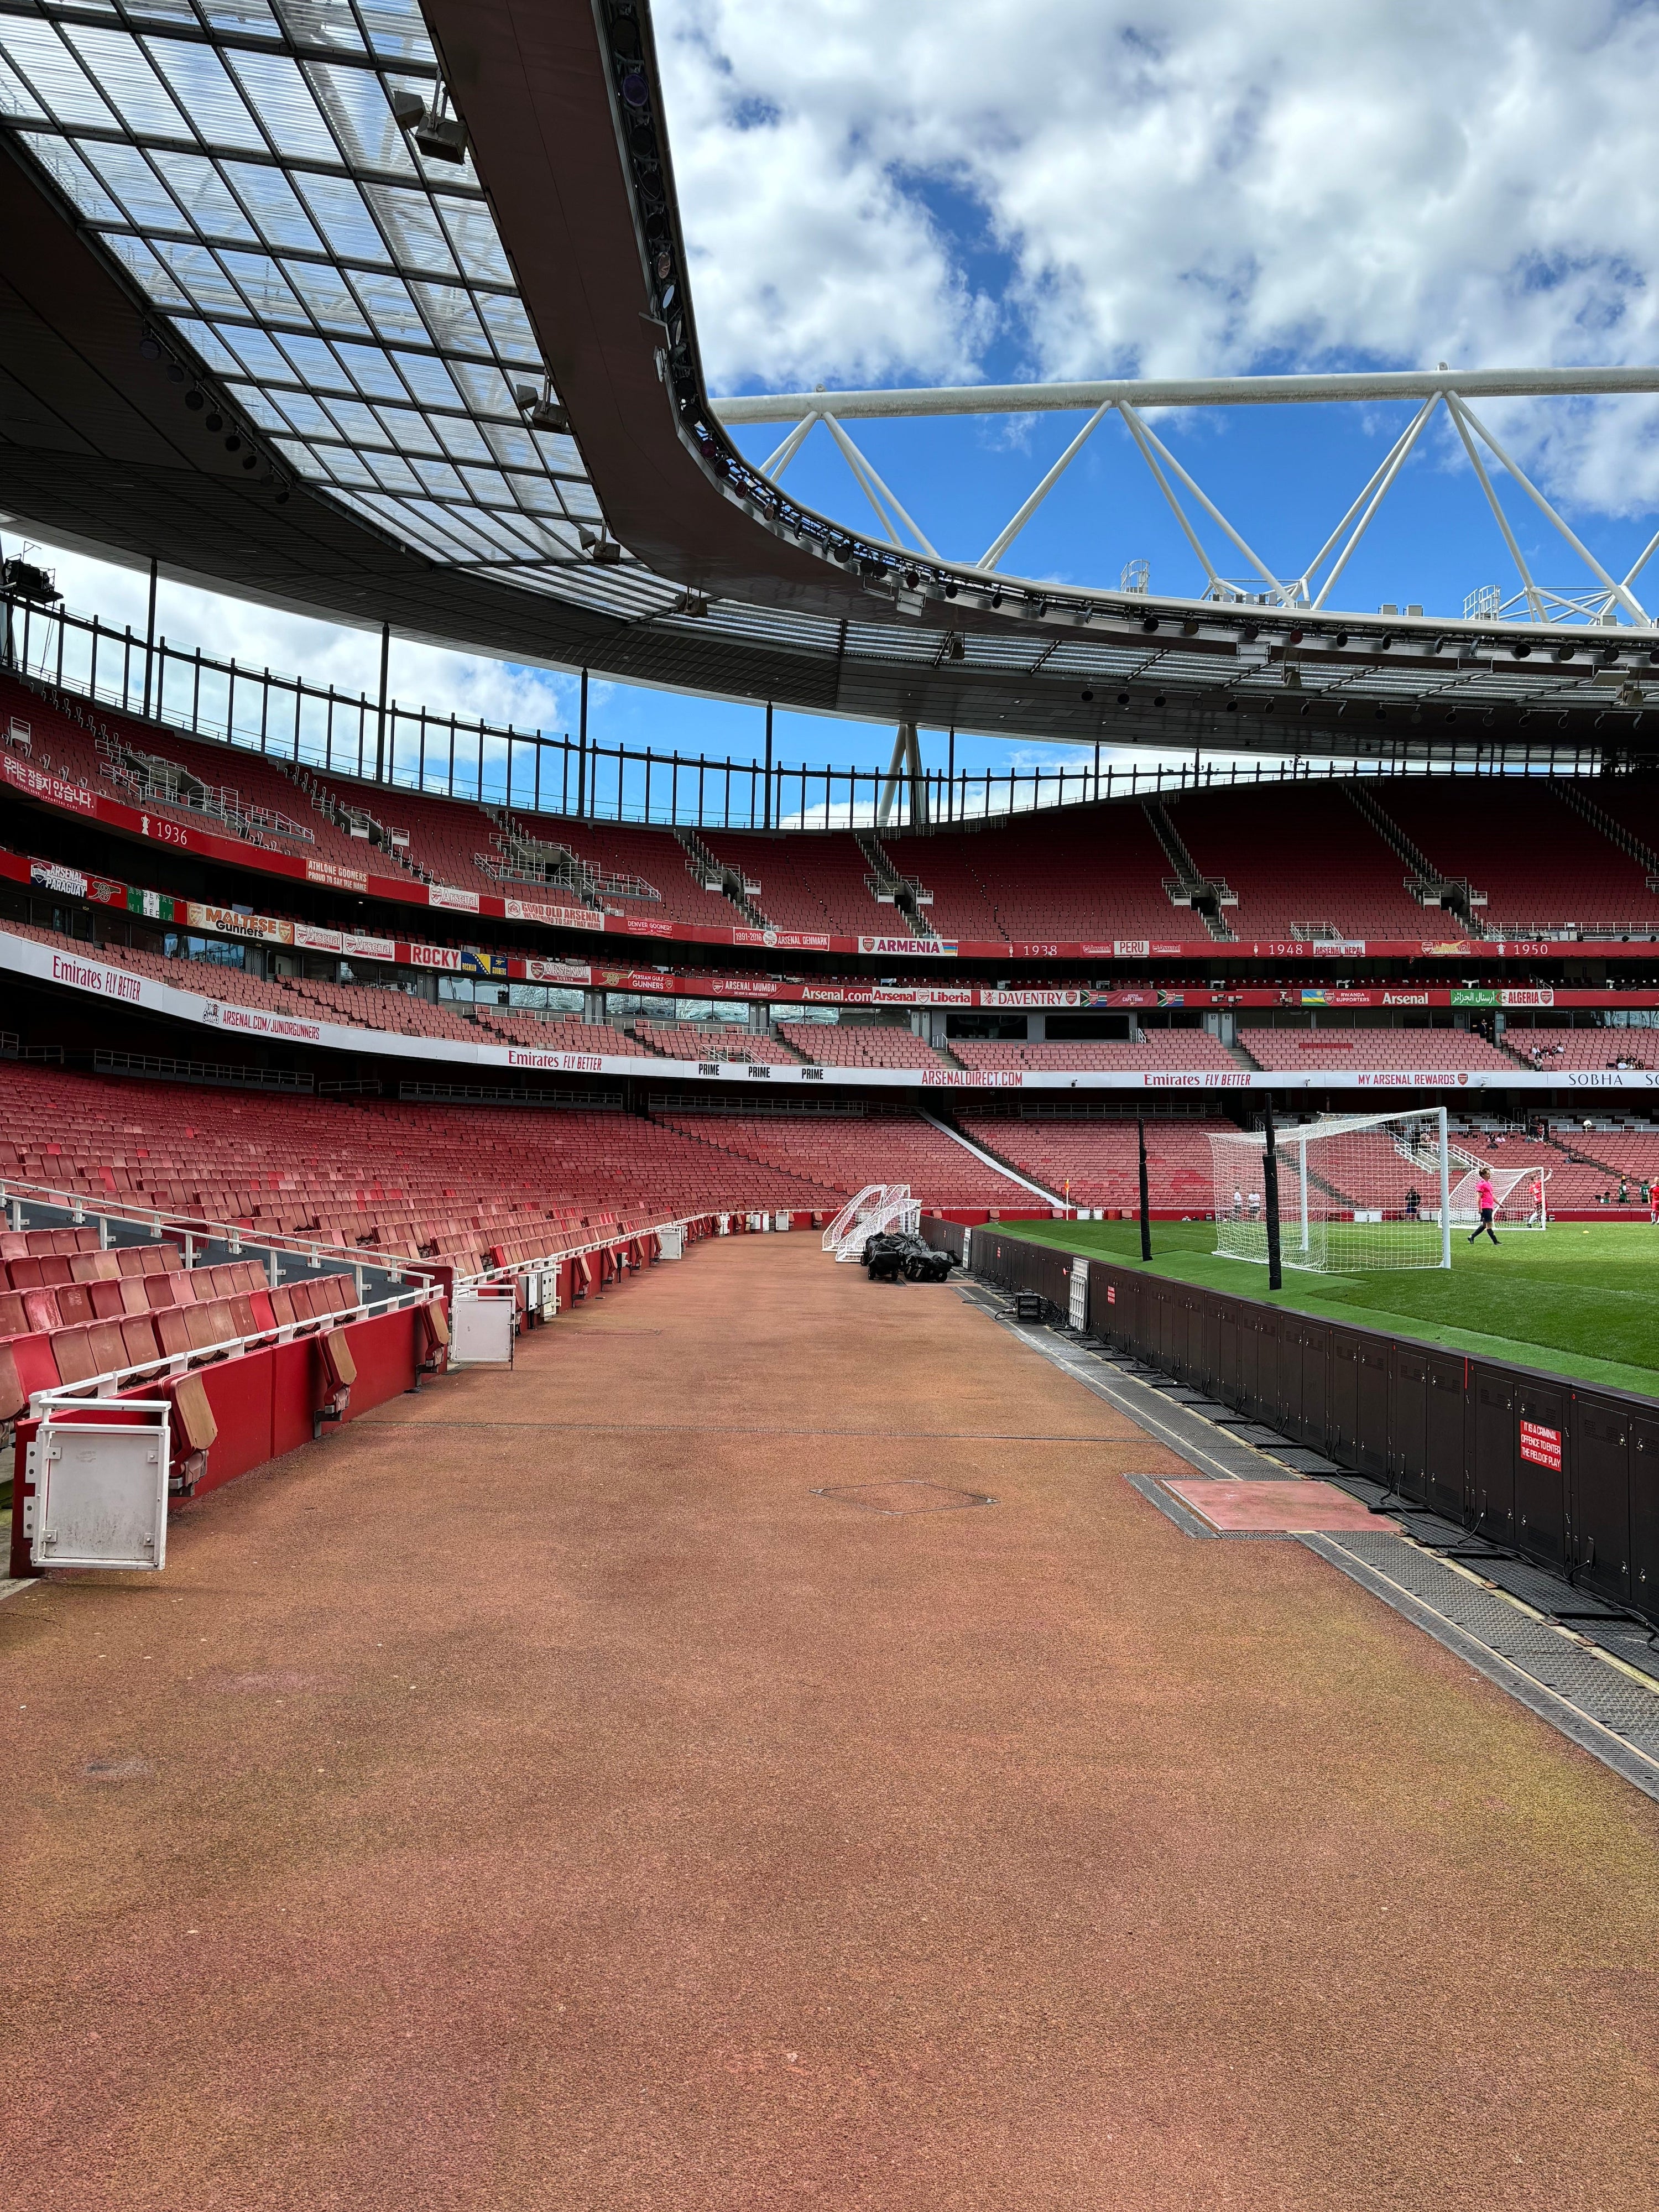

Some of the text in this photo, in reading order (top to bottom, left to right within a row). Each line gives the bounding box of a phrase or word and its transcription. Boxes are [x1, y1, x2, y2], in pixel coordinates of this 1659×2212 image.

[3, 756, 94, 808] 우리는 잠들지 않습니다.
[157, 822, 187, 846] 1936
[50, 864, 84, 884] ARSENAL
[308, 860, 367, 883] ATHLONE GOONERS
[45, 877, 86, 898] PARAGUAY
[308, 871, 325, 883] PROUD
[326, 875, 333, 884] TO
[333, 877, 343, 886] SAY
[353, 882, 367, 892] NAME
[444, 888, 478, 907] Arsenal
[521, 902, 601, 922] GOOD OLD ARSENAL
[206, 907, 277, 934] MALTESE
[649, 923, 672, 932] GOONERS
[216, 920, 264, 938] Gunners
[307, 927, 341, 946] Arsenal
[735, 932, 762, 941] 1991-2016
[778, 935, 828, 946] ARSENAL DENMARK
[356, 938, 393, 954] Arsenal
[877, 940, 940, 954] ARMENIA
[1023, 945, 1057, 956] 1938
[1119, 942, 1144, 953] PERU
[1269, 945, 1303, 955] 1948
[1315, 947, 1364, 956] ARSENAL NEPAL
[1514, 945, 1548, 955] 1950
[413, 946, 461, 968] ROCKY
[544, 963, 589, 978] ARSENAL
[53, 955, 141, 1001] Emirates FLY BETTER
[632, 980, 664, 989] GUNNERS
[725, 980, 777, 993] ARSENAL MUMBAI
[801, 987, 873, 1003] Arsenal.com
[873, 989, 971, 1003] Arsenal Liberia
[998, 993, 1063, 1005] DAVENTRY
[1382, 992, 1428, 1005] Arsenal
[1452, 991, 1496, 1005] أرسنال الجزائر
[1507, 992, 1540, 1004] ALGERIA
[508, 1050, 602, 1071] Emirates FLY BETTER
[698, 1063, 720, 1076] PRIME
[748, 1066, 770, 1078] PRIME
[802, 1068, 824, 1081] PRIME
[921, 1071, 1022, 1086] ARSENALDIRECT.COM
[1144, 1074, 1251, 1086] Emirates FLY BETTER
[1358, 1074, 1455, 1085] MY ARSENAL REWARDS
[1569, 1073, 1623, 1086] SOBHA
[1524, 1422, 1557, 1441] IT IS A CRIMINAL
[1521, 1433, 1561, 1455] OFFENCE TO ENTER
[1522, 1446, 1561, 1468] THE FIELD OF PLAY
